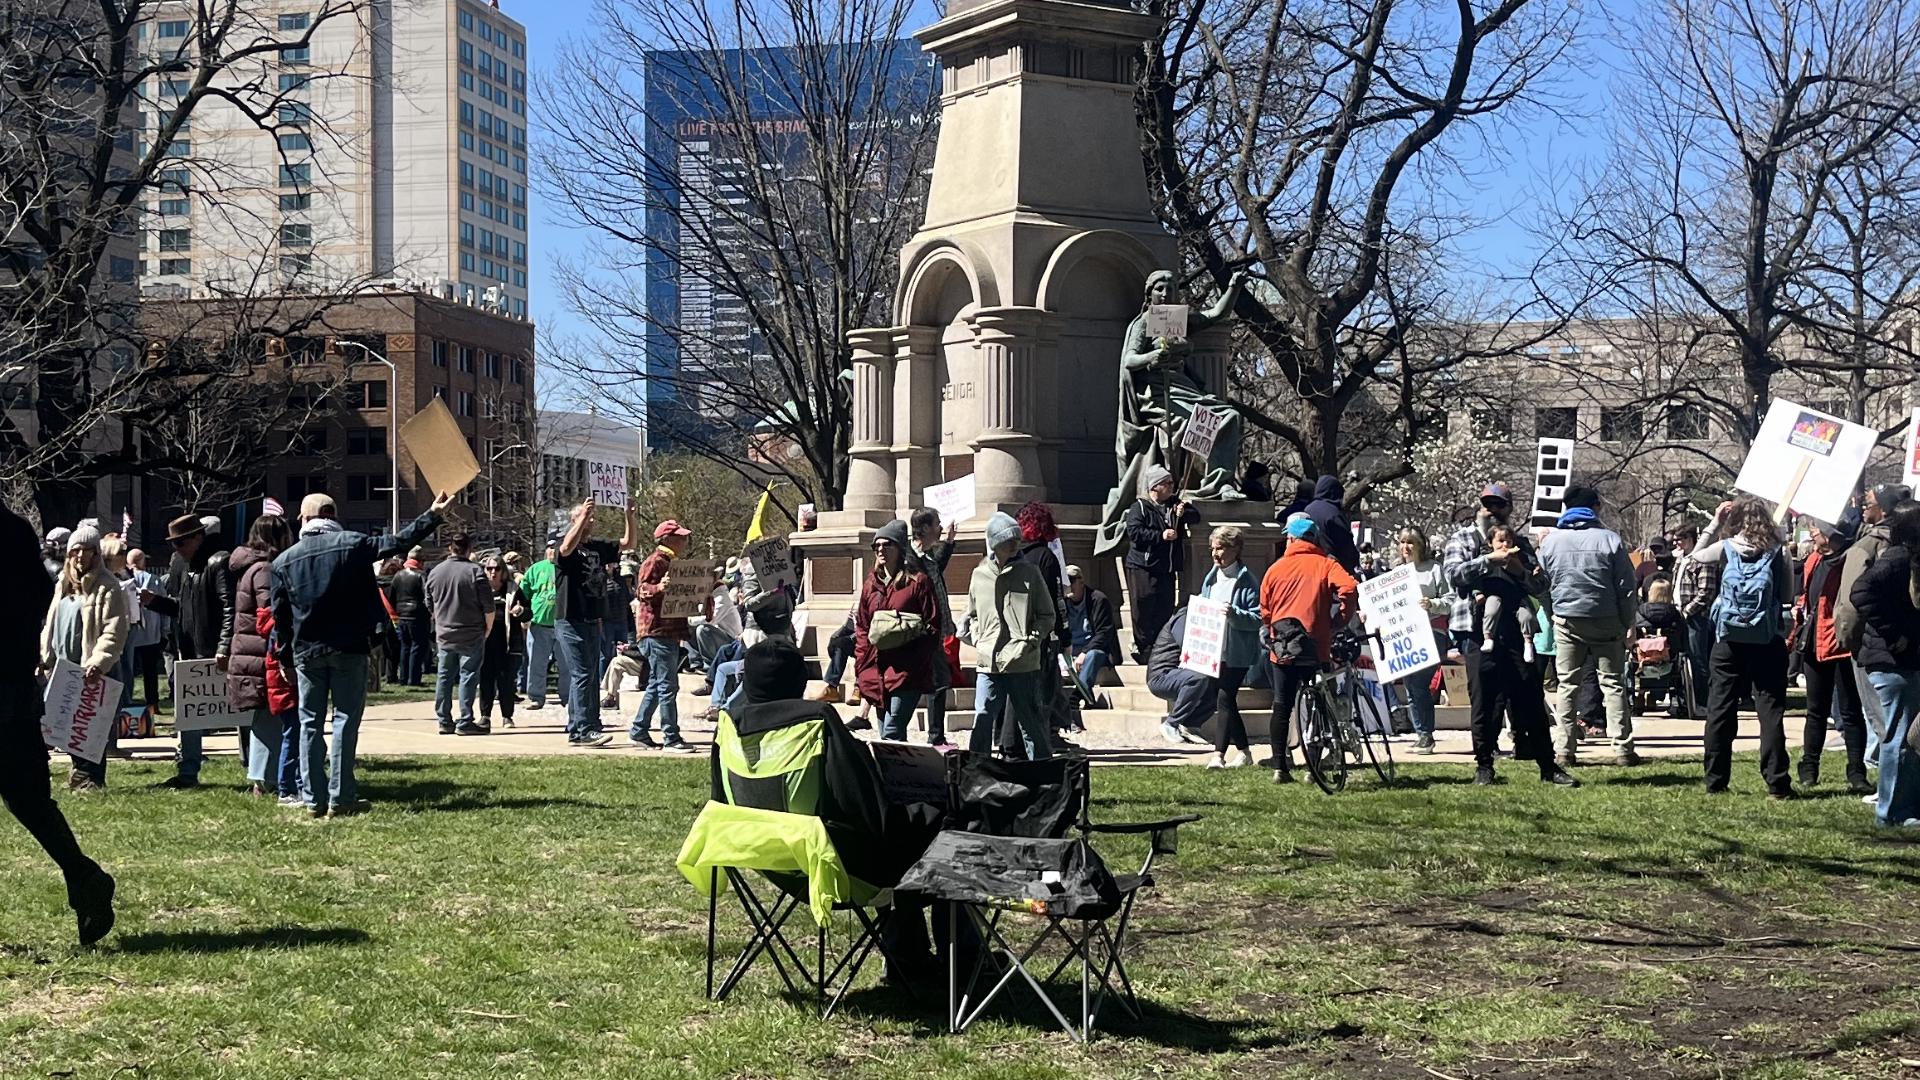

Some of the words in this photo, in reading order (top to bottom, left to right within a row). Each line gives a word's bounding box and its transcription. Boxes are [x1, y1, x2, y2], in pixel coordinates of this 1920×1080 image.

[680, 122, 707, 136] LIVE
[710, 121, 743, 136] FRO
[751, 119, 773, 135] THE
[776, 118, 832, 134] BRACT
[1195, 406, 1222, 431] VOTE
[590, 461, 624, 479] DRAFT
[597, 473, 623, 491] MAGA
[592, 489, 627, 507] FIRST
[761, 559, 789, 577] COMING
[1364, 582, 1376, 592] HEY
[1371, 591, 1389, 604] DON'T
[1392, 583, 1408, 596] BEND
[1379, 605, 1390, 615] THE
[1392, 598, 1408, 610] KNEE
[1389, 617, 1397, 625] TO
[1392, 636, 1412, 656] NO
[1388, 647, 1429, 674] KINGS
[190, 662, 226, 679] STO
[182, 682, 228, 699] KILLI
[184, 701, 237, 718] PEOPL
